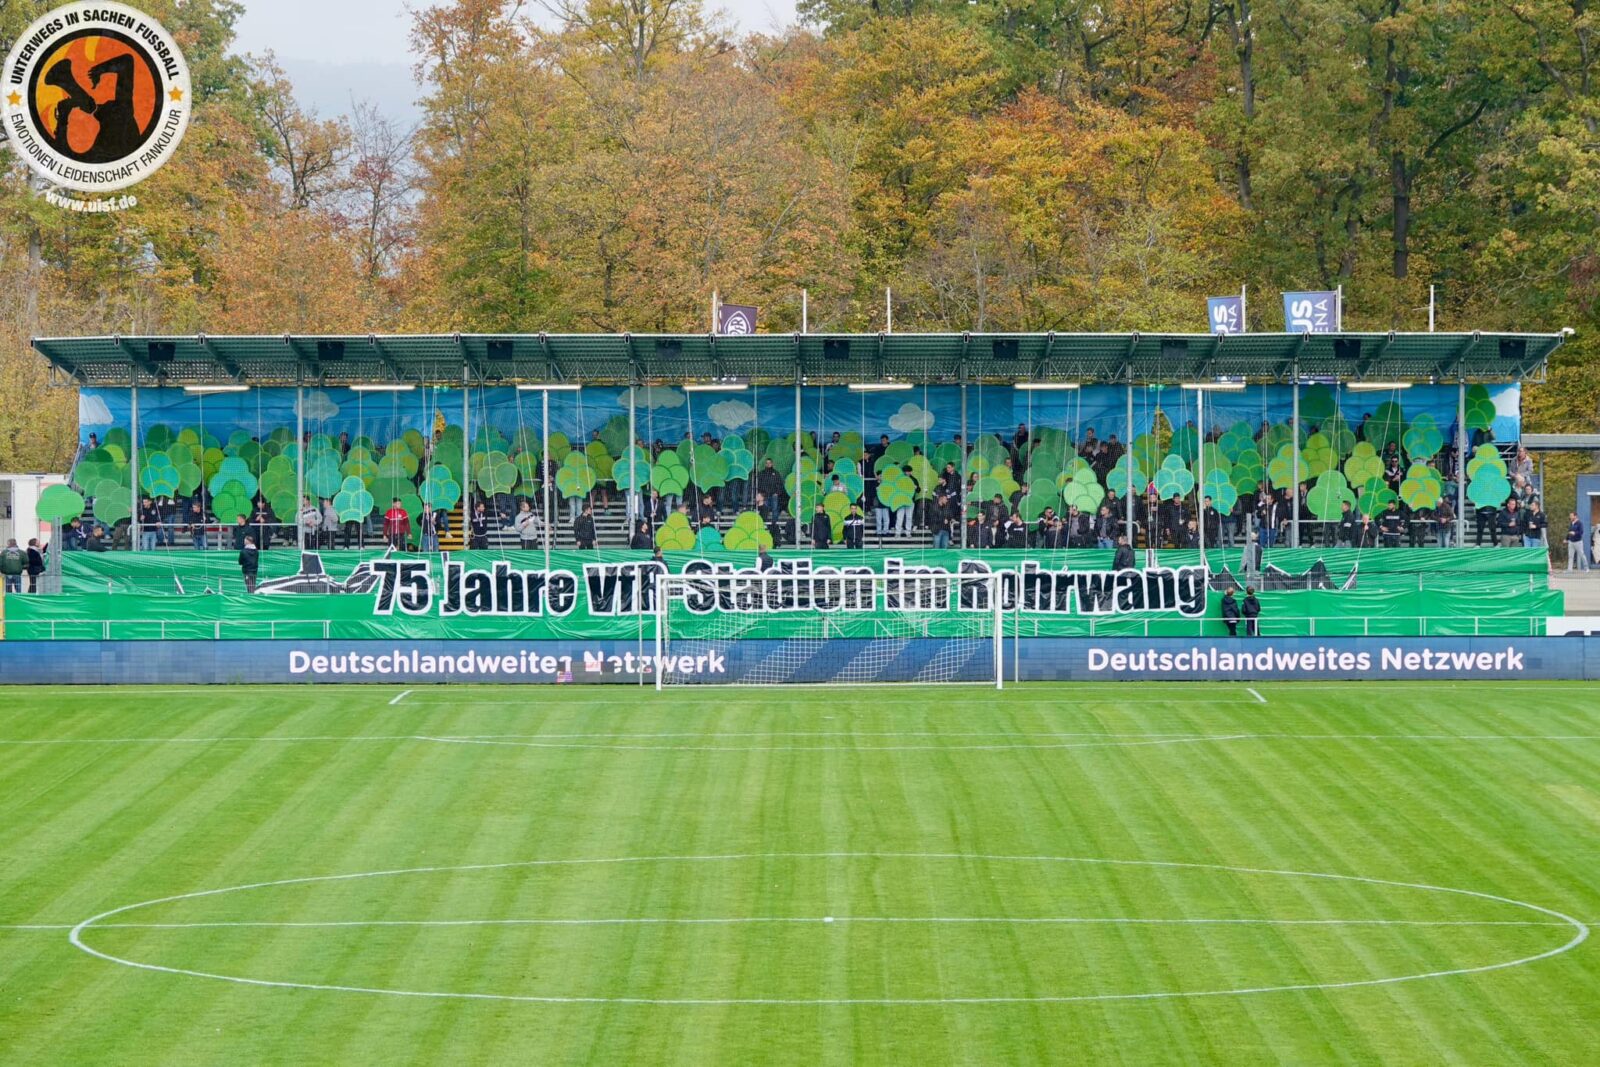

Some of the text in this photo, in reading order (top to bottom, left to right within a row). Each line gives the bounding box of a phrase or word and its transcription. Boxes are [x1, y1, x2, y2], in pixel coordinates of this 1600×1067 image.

[370, 560, 430, 615] 75
[439, 560, 578, 616] Jahre
[884, 558, 950, 611] im
[958, 560, 1208, 617] Rohrwang
[1087, 646, 1524, 672] Deutschlandweites Netzwerk
